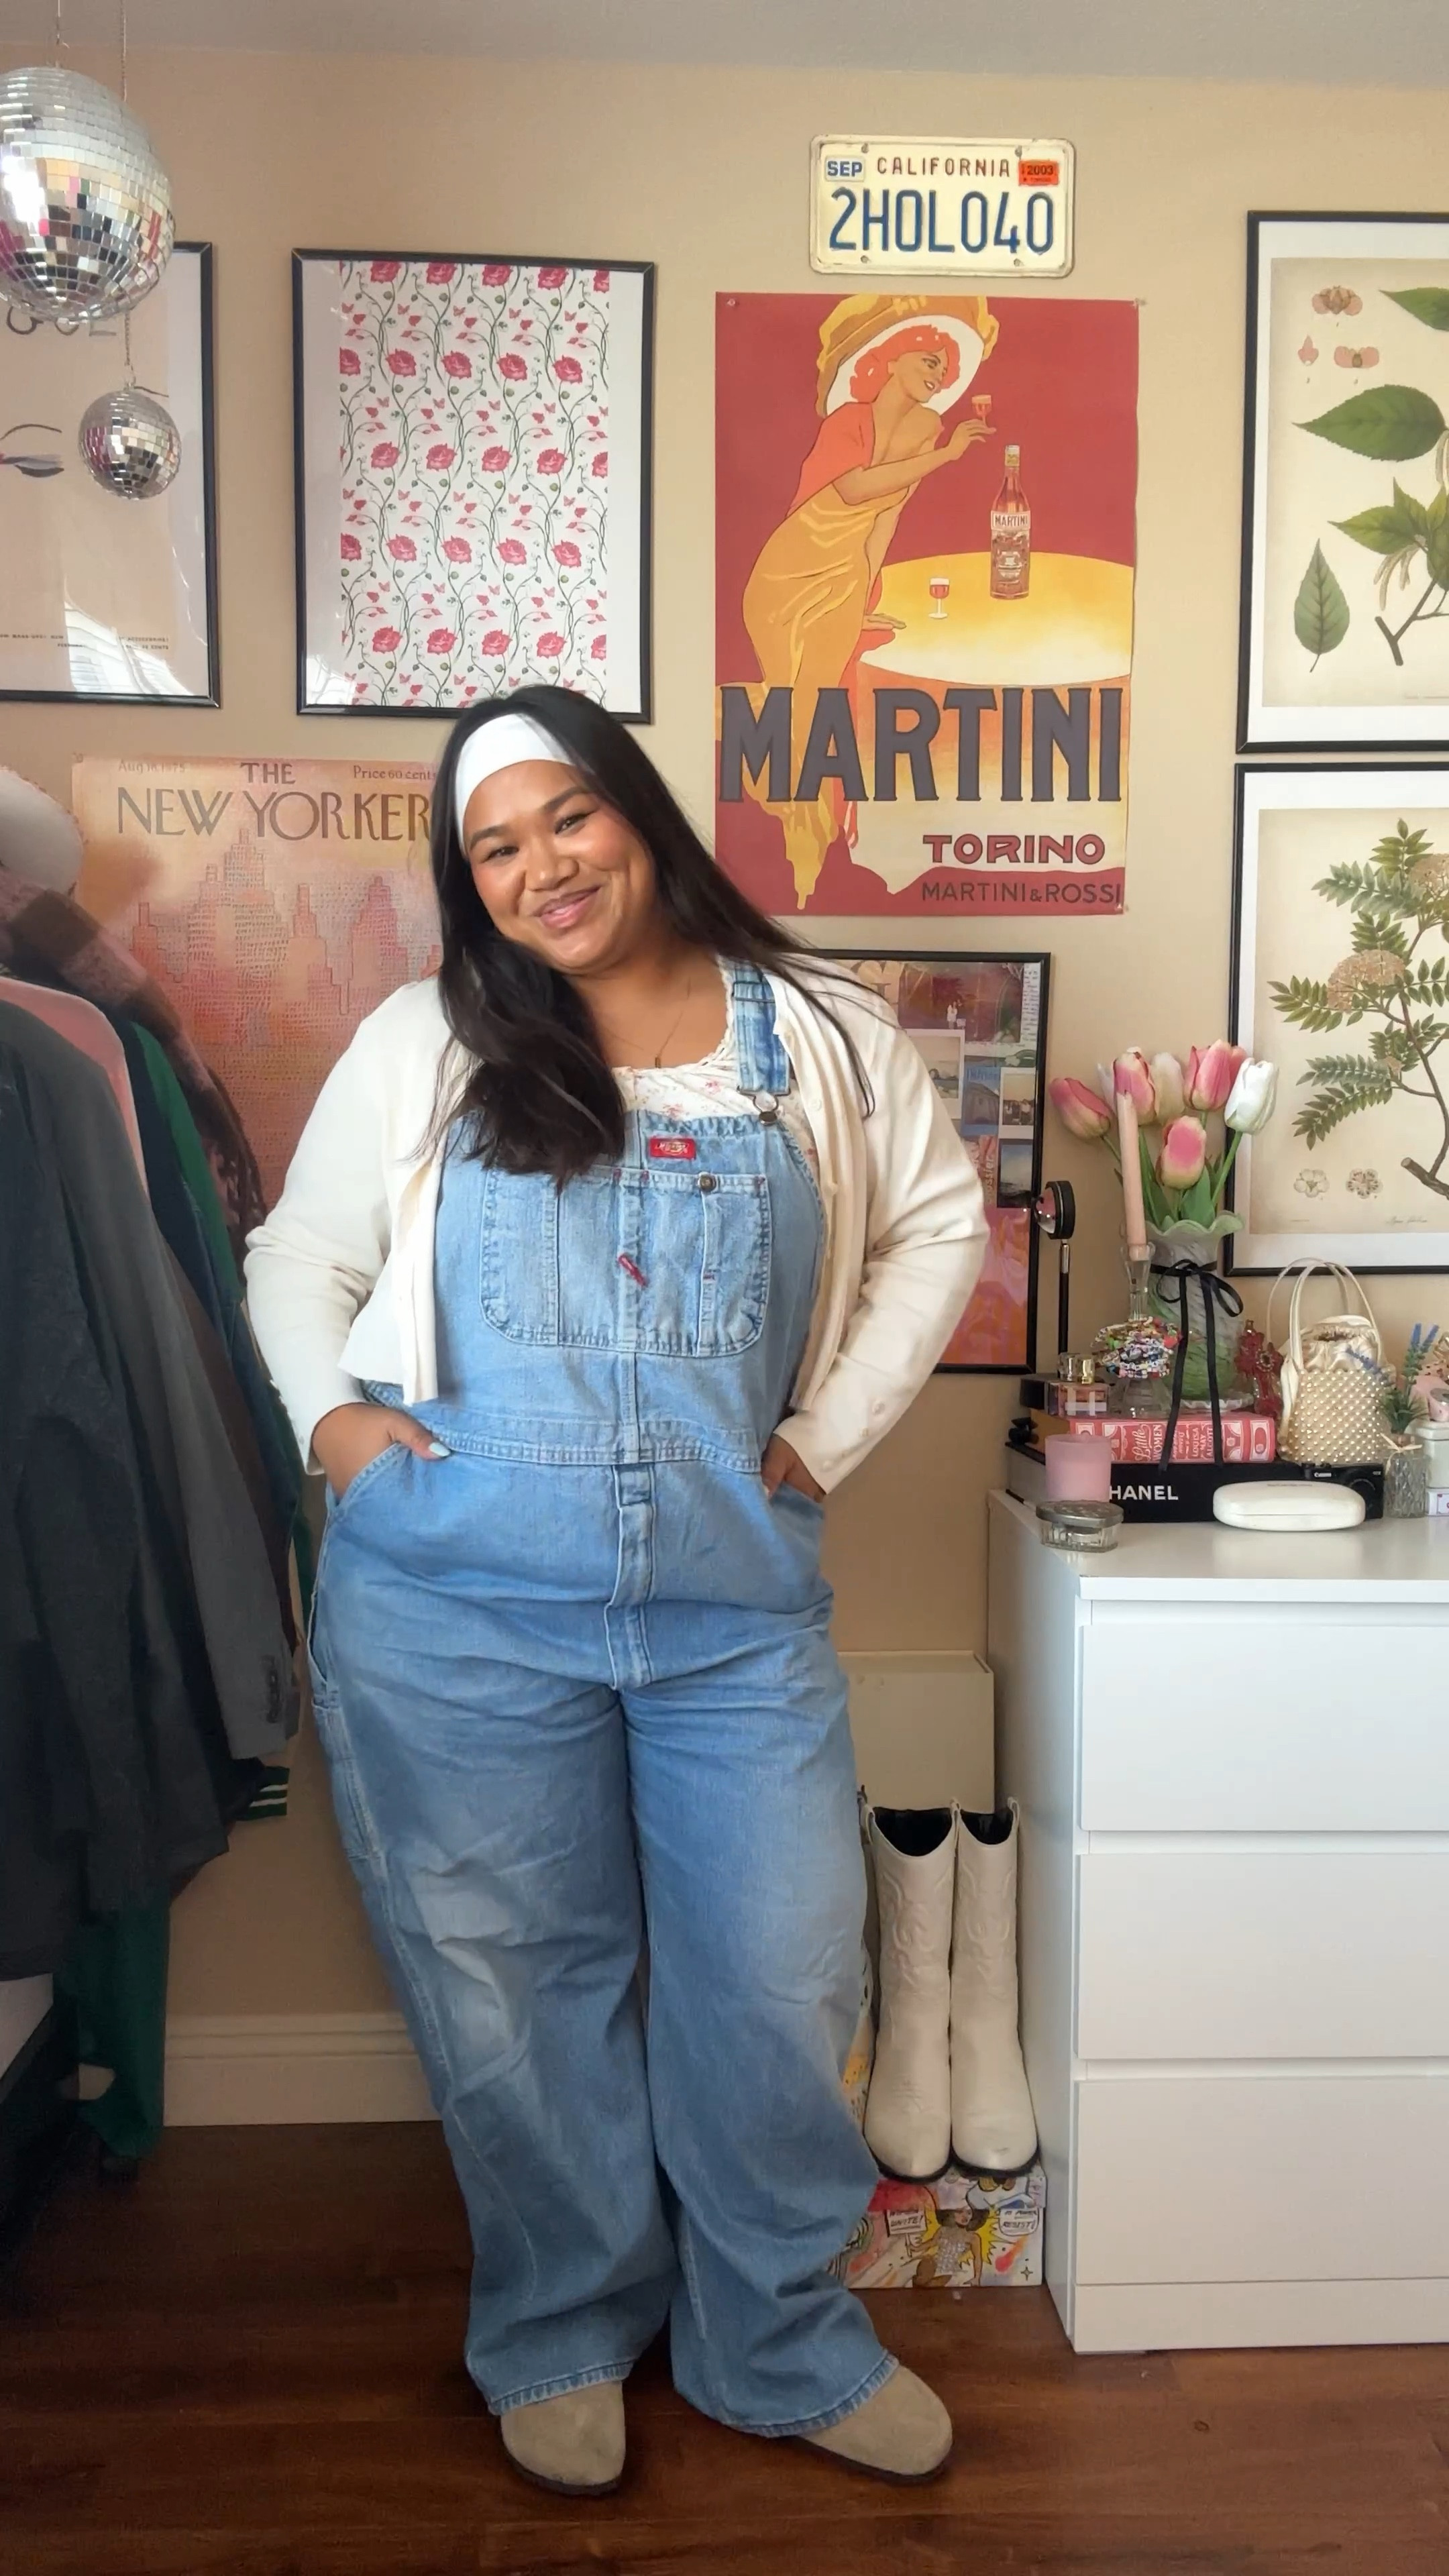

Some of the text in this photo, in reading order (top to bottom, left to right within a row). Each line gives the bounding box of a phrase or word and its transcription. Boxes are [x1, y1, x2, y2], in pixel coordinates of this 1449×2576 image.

[827, 160, 863, 177] SEP
[877, 156, 1010, 178] CALIFORNIA
[1027, 165, 1053, 175] 2003
[994, 515, 1028, 527] MARTINI
[719, 686, 1123, 802] MARTINI
[240, 762, 296, 784] THE
[354, 765, 386, 779] Price
[118, 786, 431, 842] NEW YORKER
[922, 833, 1106, 865] TORINO
[1132, 1424, 1152, 1460] Little
[1152, 1424, 1163, 1460] WOMEN
[1109, 1485, 1179, 1501] HANEL
